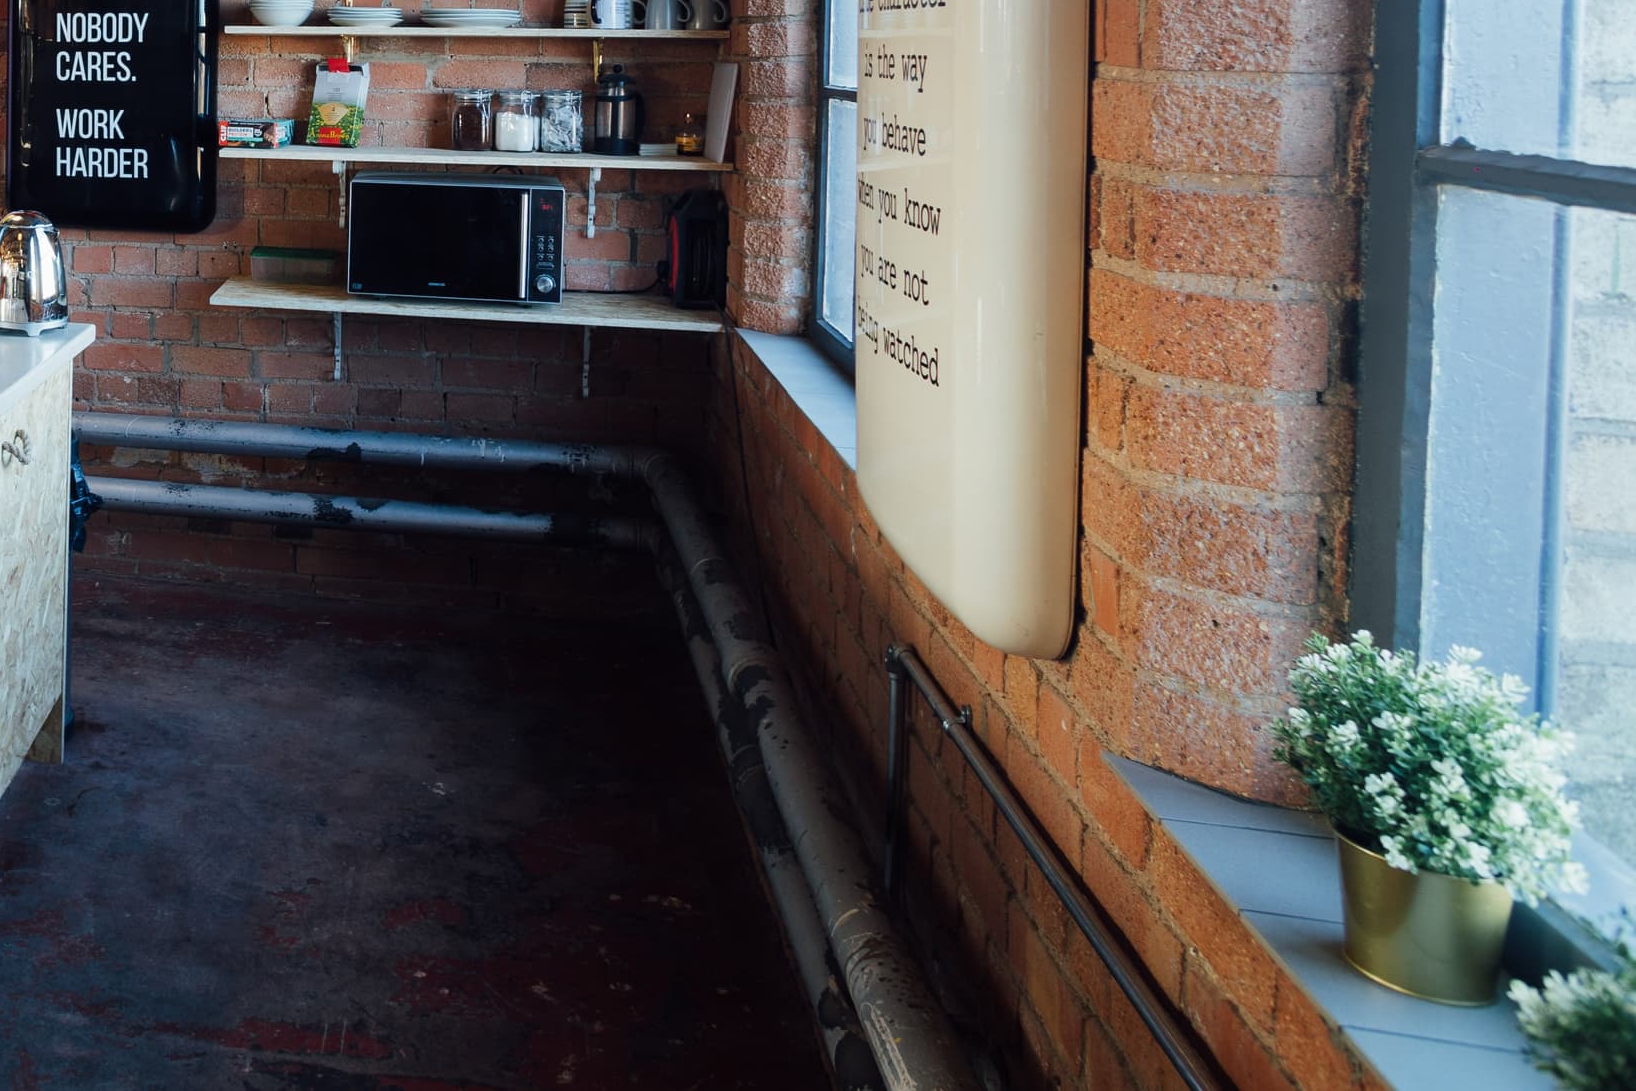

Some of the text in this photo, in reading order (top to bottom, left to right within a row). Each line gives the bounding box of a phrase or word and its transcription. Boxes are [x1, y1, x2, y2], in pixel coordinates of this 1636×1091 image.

[56, 12, 149, 43] NOBODY
[56, 51, 137, 82] CARES.
[865, 42, 927, 93] is the way
[56, 108, 125, 139] WORK
[863, 112, 926, 156] you behave
[56, 147, 149, 179] HARDER
[878, 189, 897, 224] you
[904, 188, 941, 236] know
[861, 244, 929, 306] you are not
[883, 327, 939, 387] watched
